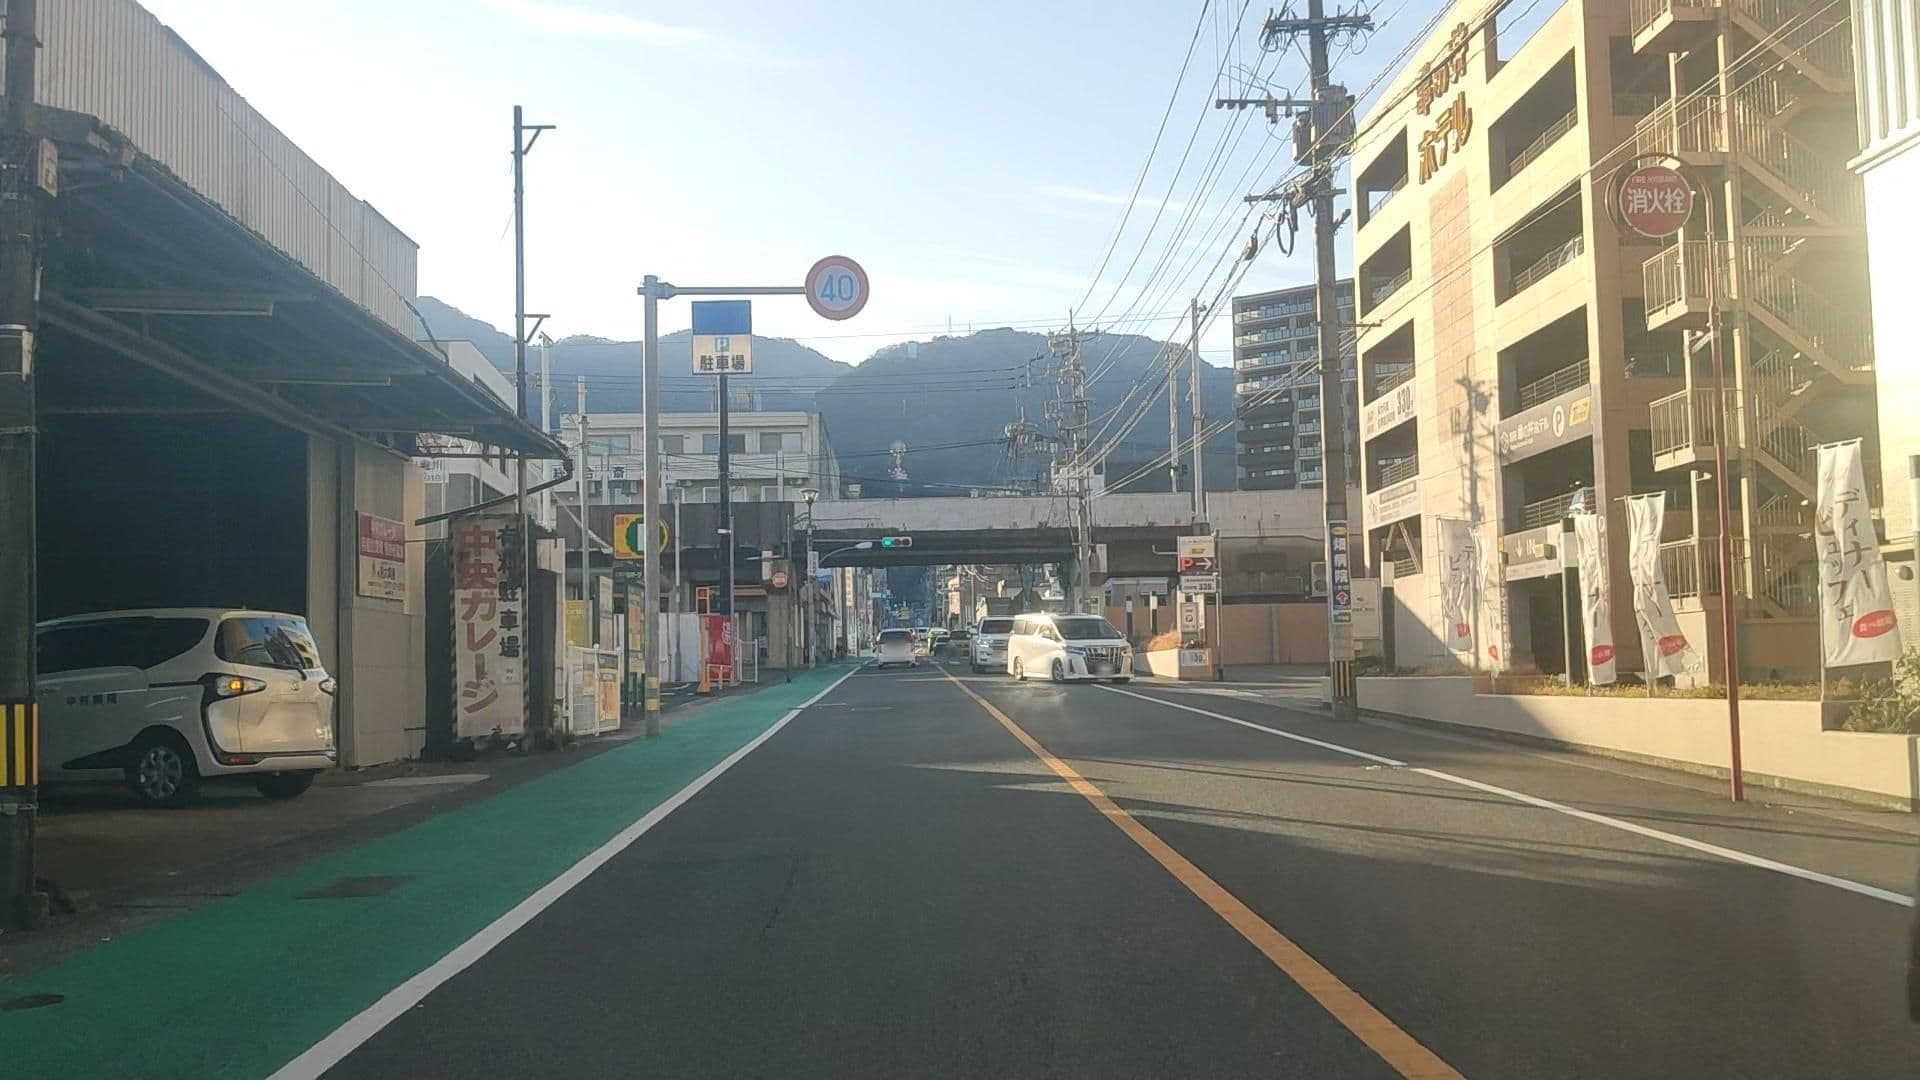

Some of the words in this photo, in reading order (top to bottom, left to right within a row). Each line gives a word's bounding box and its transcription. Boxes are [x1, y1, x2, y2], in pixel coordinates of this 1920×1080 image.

[1418, 91, 1473, 185] ホテル
[1627, 187, 1686, 214] 消火栓
[820, 274, 855, 302] 40
[716, 338, 728, 351] P
[699, 354, 745, 371] 駐車場
[1835, 487, 1873, 590] ディナー
[1181, 558, 1194, 571] P
[1815, 505, 1854, 622] ビュッフェ
[455, 525, 498, 714] 中央ガレージ
